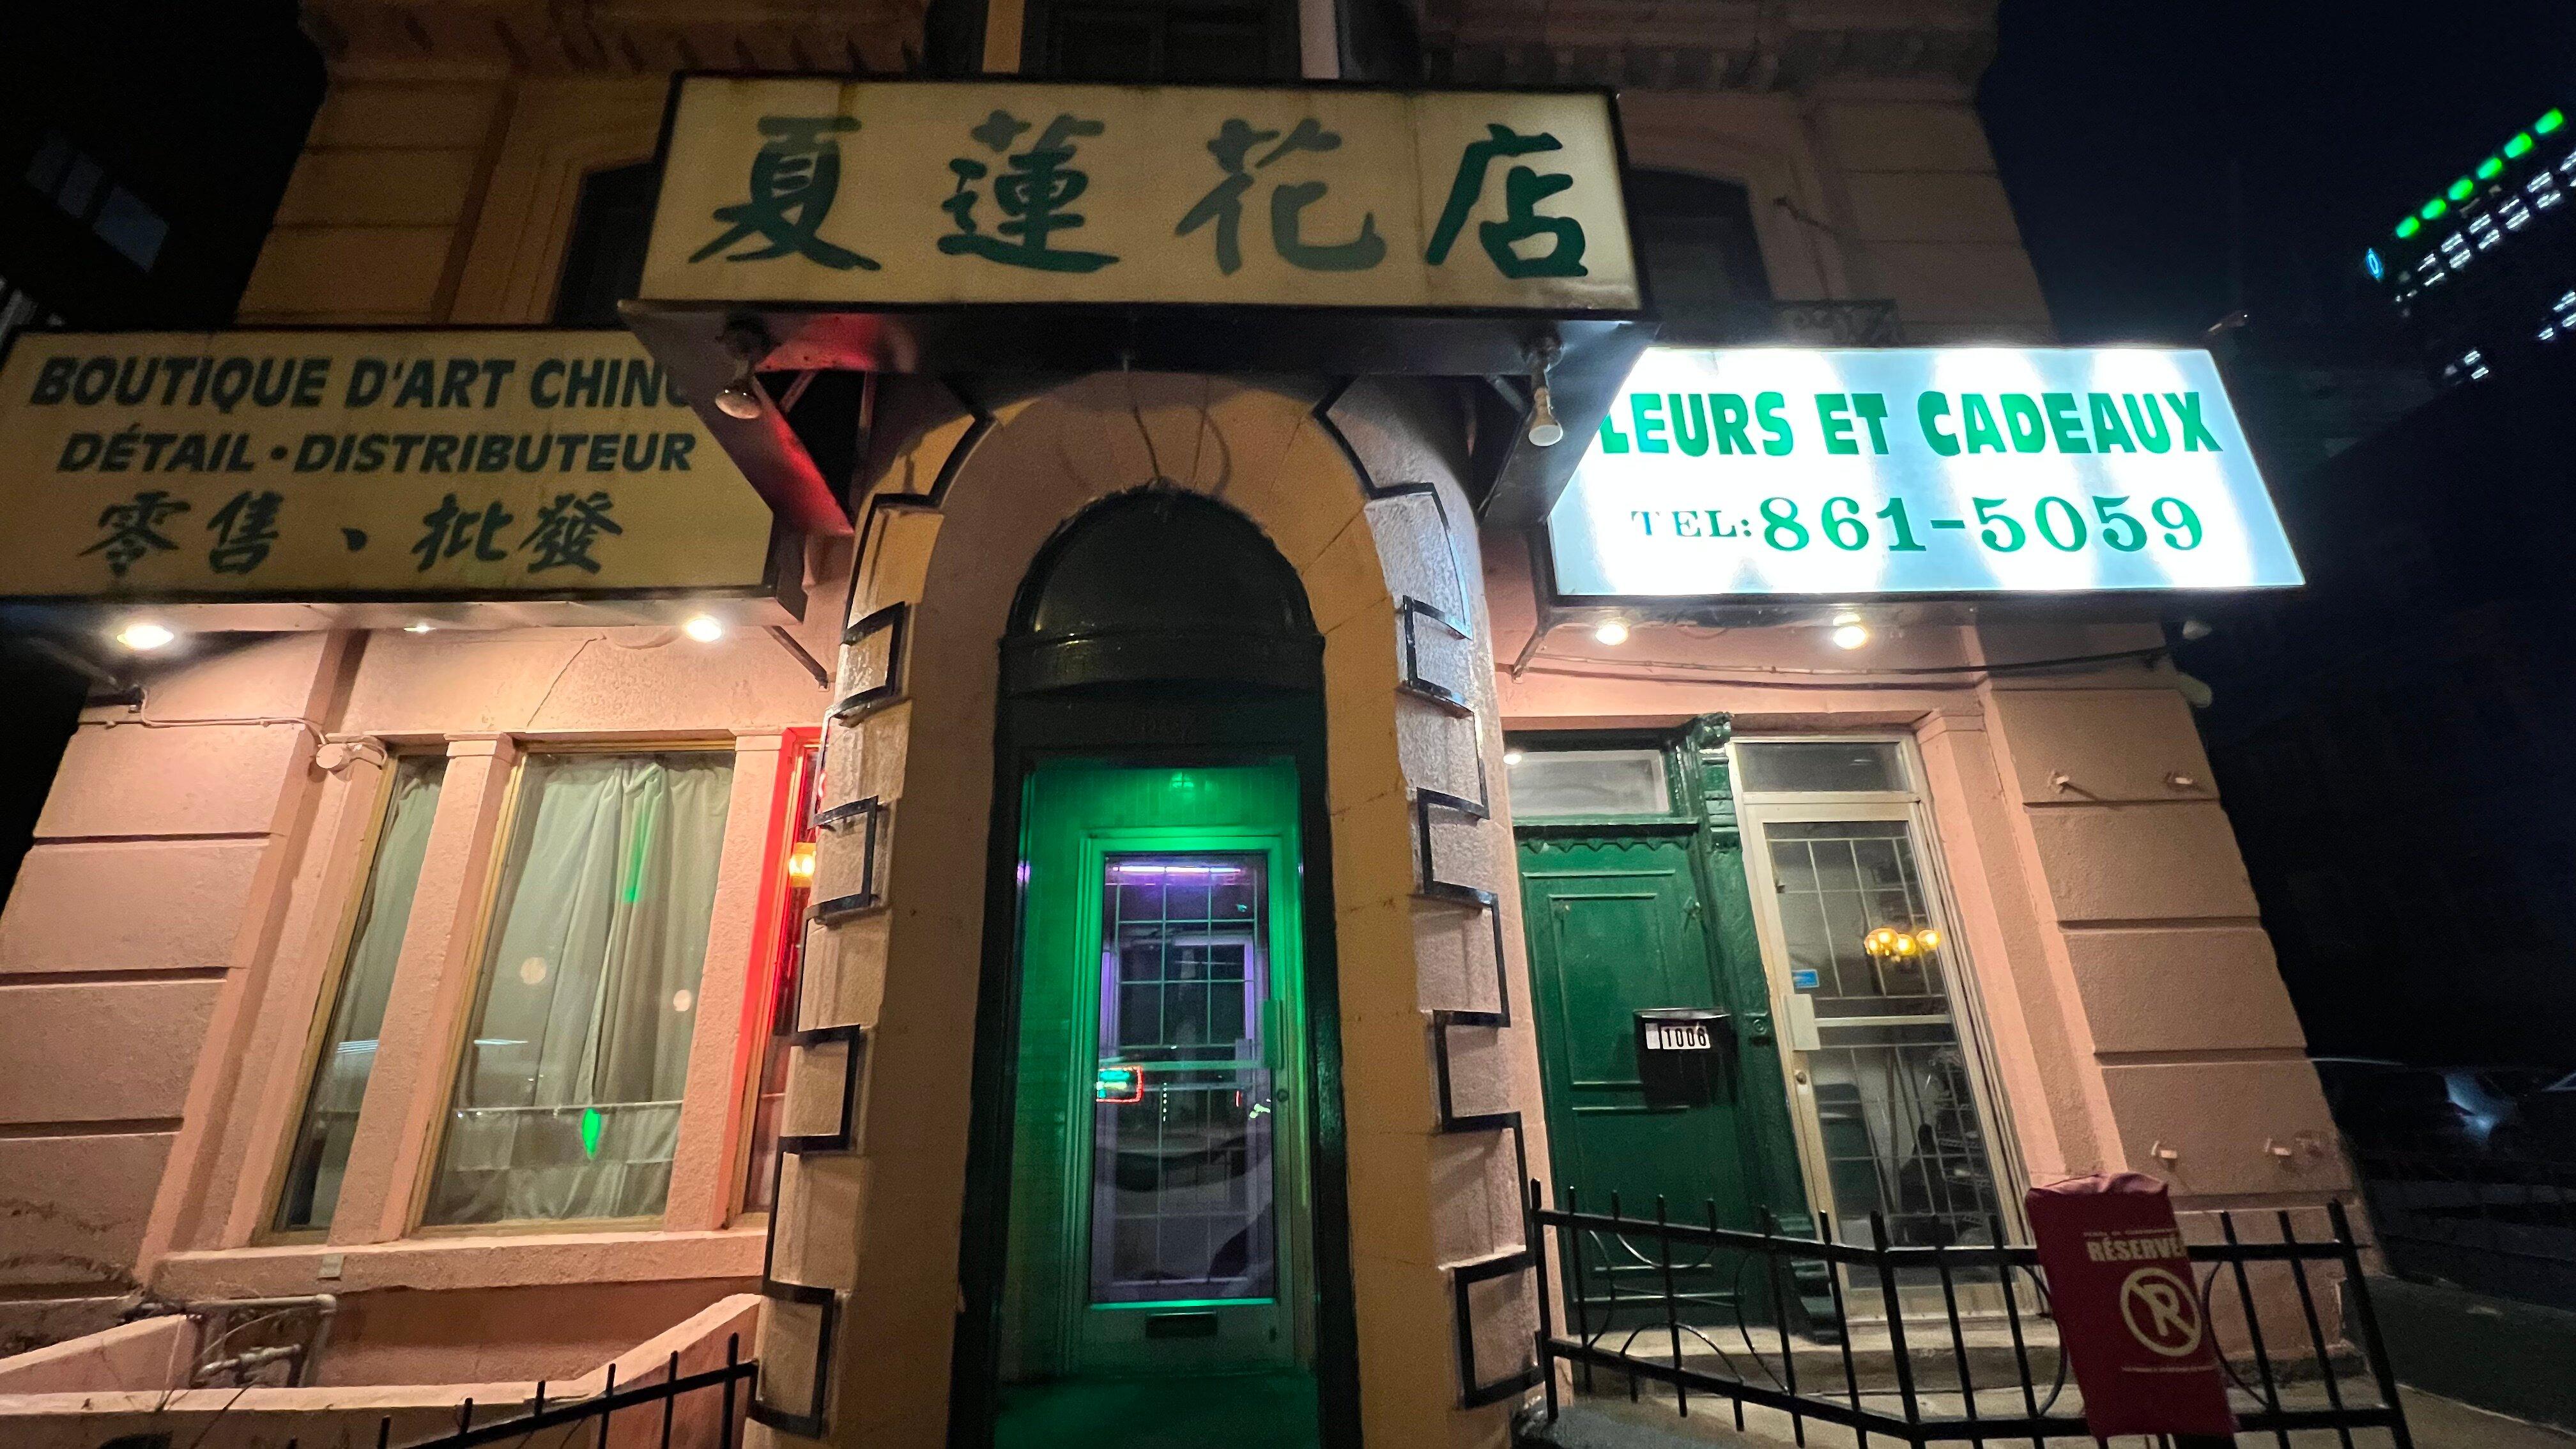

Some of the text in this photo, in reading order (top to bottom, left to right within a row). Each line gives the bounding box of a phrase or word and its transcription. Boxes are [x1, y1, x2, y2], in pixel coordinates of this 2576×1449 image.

[687, 109, 1588, 277] 夏蓮花店
[29, 356, 331, 413] BOUTIQUE
[344, 358, 516, 408] D'ART
[56, 422, 696, 473] DÉTAIL DISTRIBUTEUR
[1814, 392, 1890, 455] ET
[1917, 390, 2223, 456] CADEAUX
